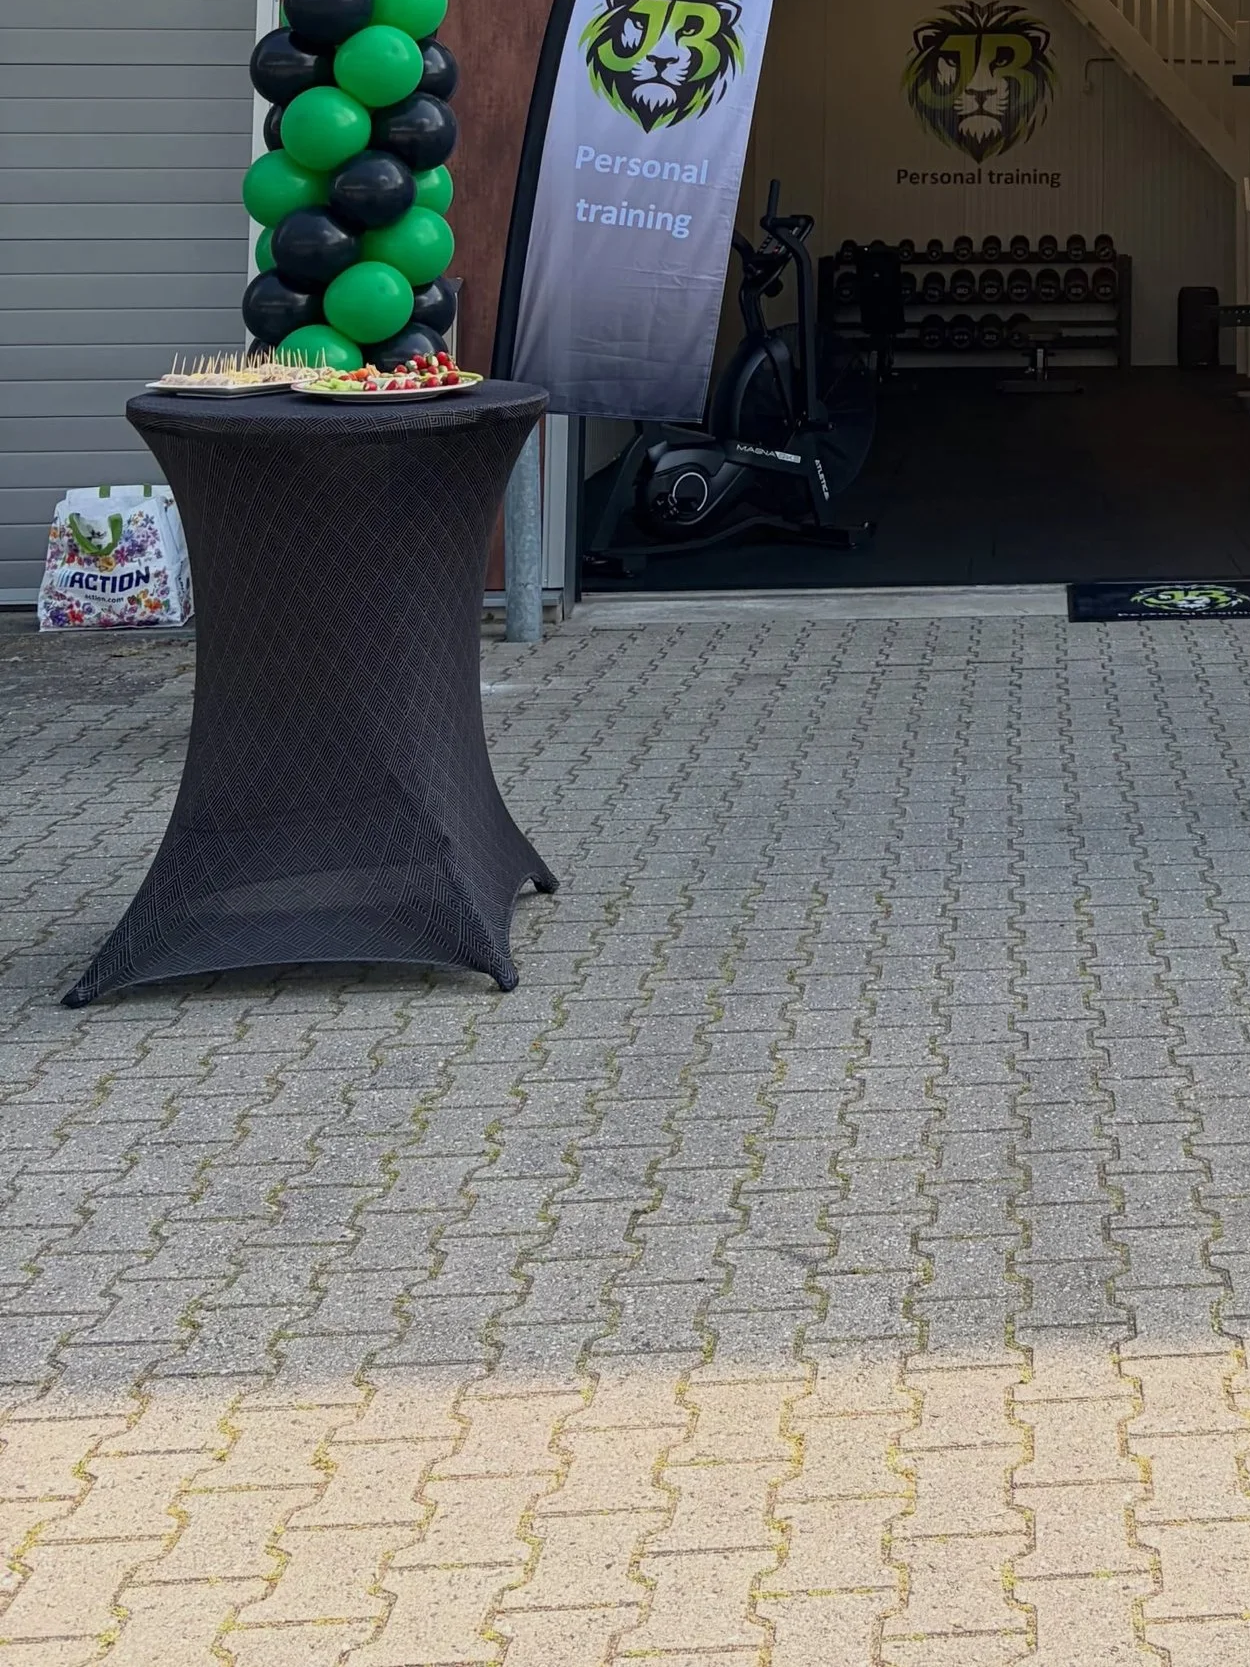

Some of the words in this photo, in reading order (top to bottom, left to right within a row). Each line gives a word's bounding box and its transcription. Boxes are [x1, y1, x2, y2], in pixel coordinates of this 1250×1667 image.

[576, 145, 708, 184] Personal
[896, 168, 982, 185] Personal
[988, 169, 1062, 189] training
[576, 198, 692, 238] training
[69, 566, 151, 593] ACTION
[84, 594, 124, 604] action.com
